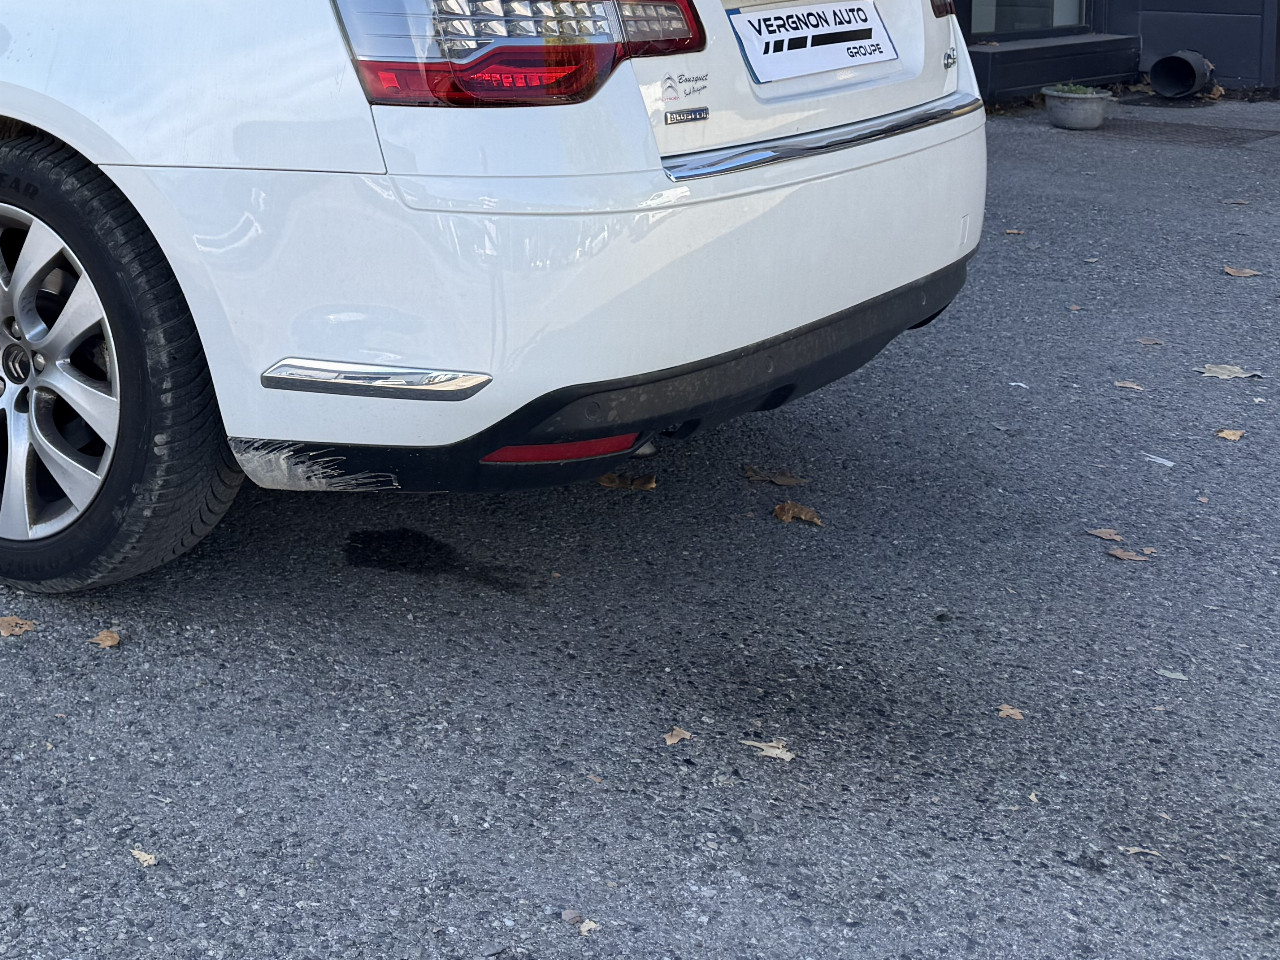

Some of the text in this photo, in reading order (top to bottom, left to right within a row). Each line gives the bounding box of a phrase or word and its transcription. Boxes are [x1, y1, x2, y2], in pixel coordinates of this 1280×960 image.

[747, 6, 869, 36] VERGNON AUTO
[846, 43, 883, 58] GROUPE
